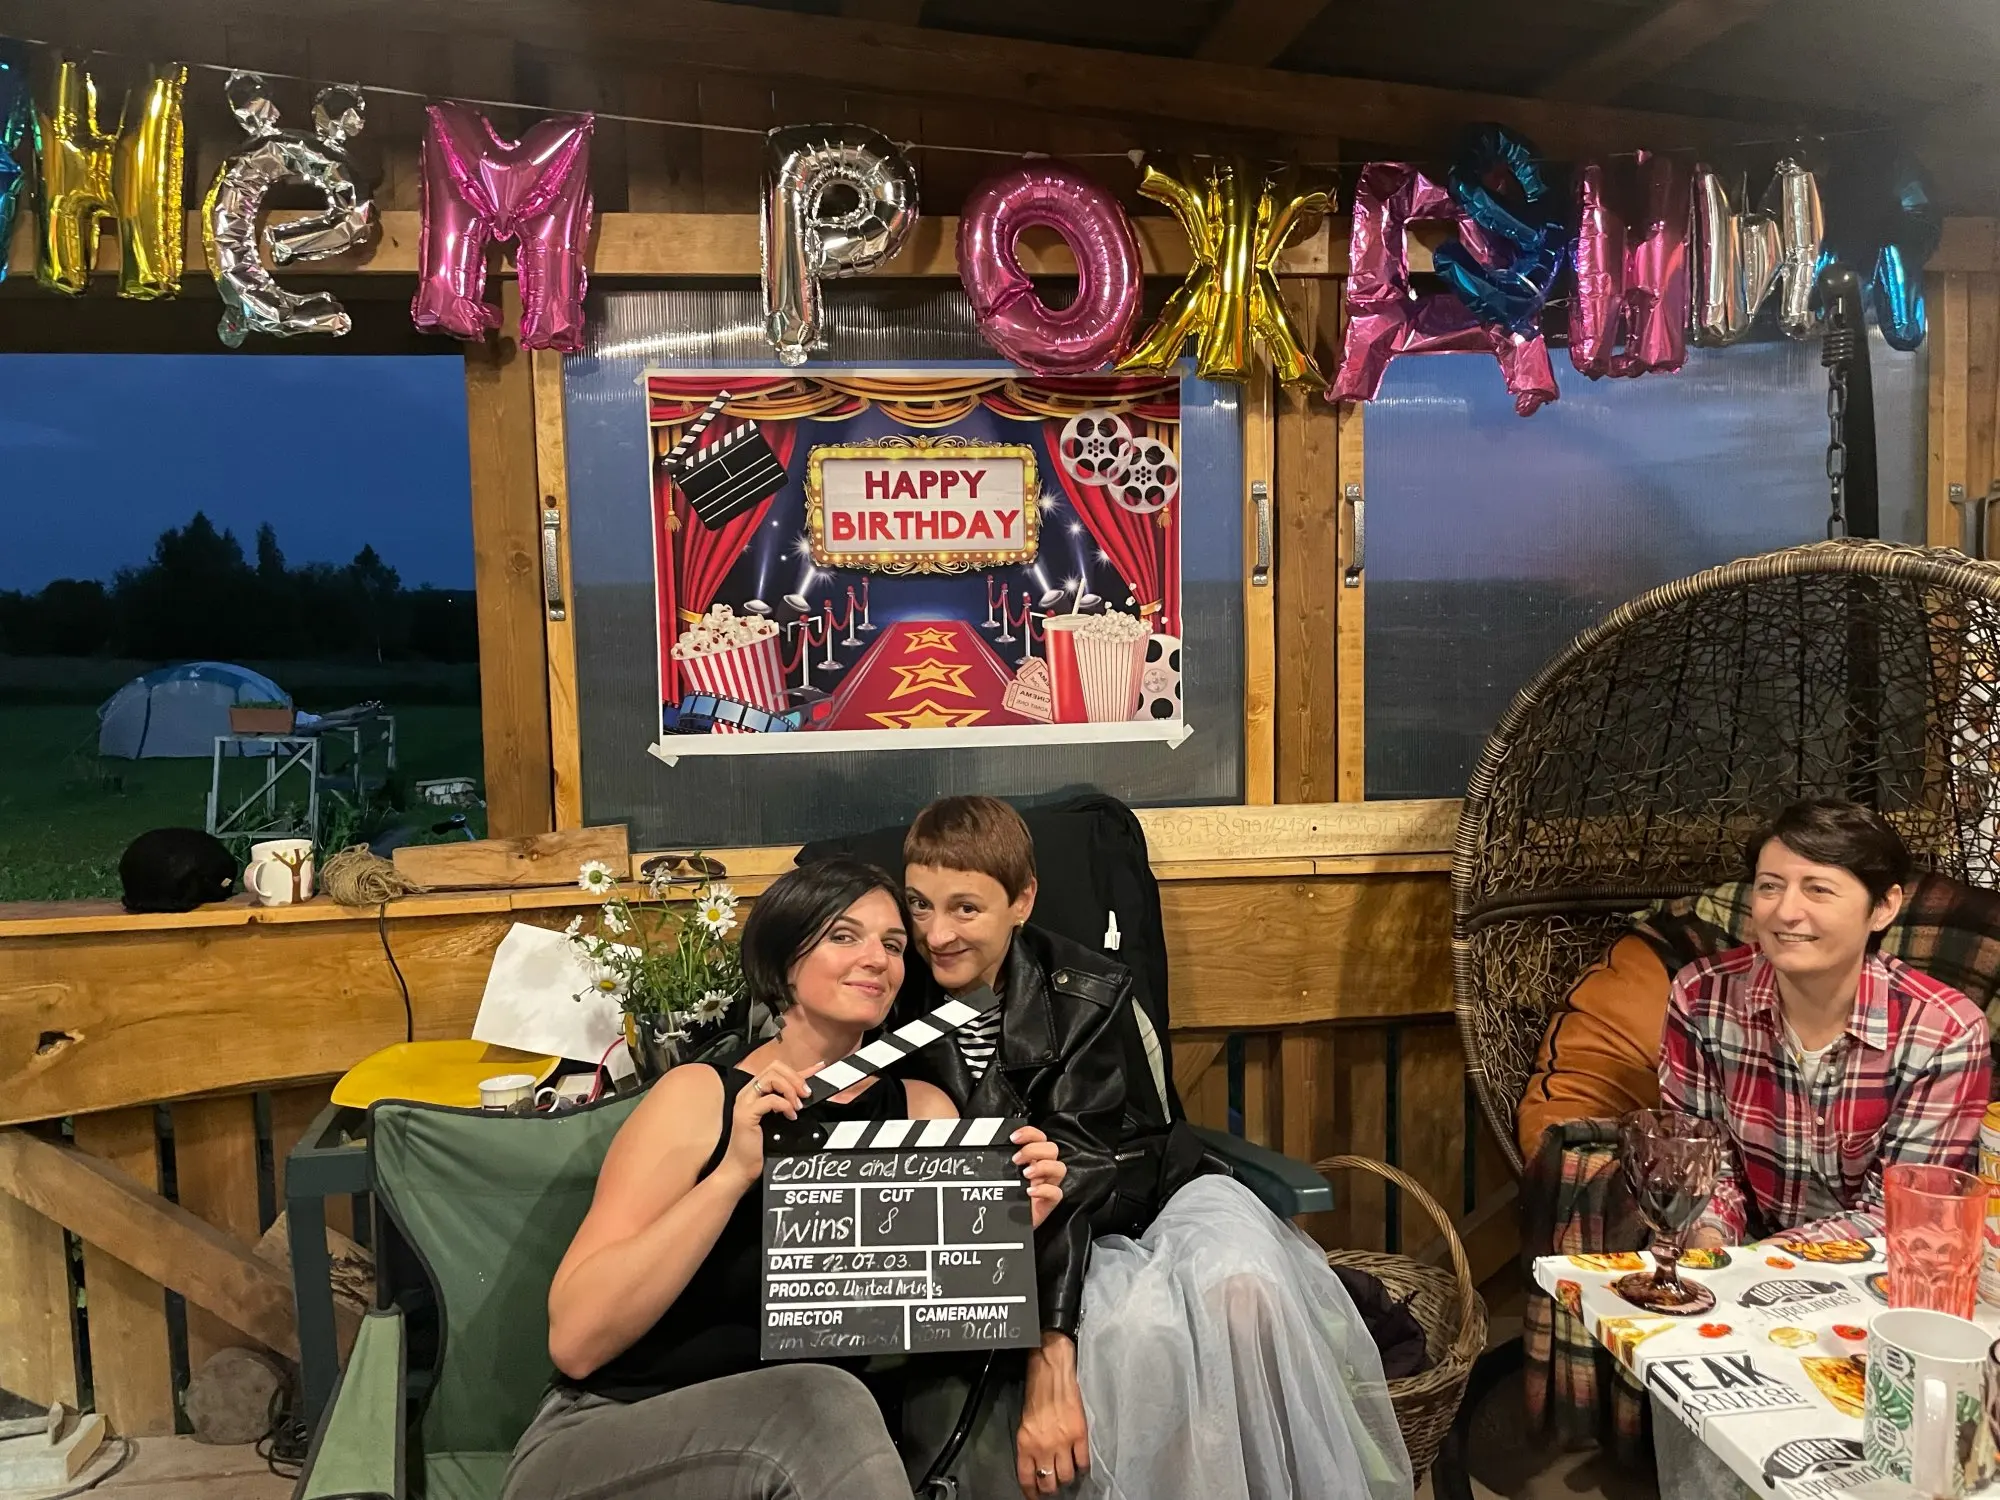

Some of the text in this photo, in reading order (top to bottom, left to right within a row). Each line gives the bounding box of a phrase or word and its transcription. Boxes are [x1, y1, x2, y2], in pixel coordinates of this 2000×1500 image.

[865, 470, 987, 500] HAPPY
[831, 510, 1020, 541] BIRTHDAY
[772, 1153, 851, 1181] Coffee
[859, 1154, 898, 1178] and
[784, 1190, 843, 1205] SCENE
[879, 1188, 914, 1203] CUT
[961, 1188, 1004, 1201] TAKE
[768, 1206, 853, 1247] Twins
[878, 1207, 899, 1234] 8
[971, 1206, 987, 1235] 8
[769, 1255, 814, 1270] DATE
[938, 1251, 982, 1266] ROLL
[769, 1282, 839, 1298] PROD.CO.
[842, 1279, 893, 1297] United
[767, 1310, 843, 1327] DIRECTOR
[915, 1305, 1009, 1322] CAMERAMAN
[1646, 1355, 1785, 1402] TEAK
[1682, 1387, 1809, 1429] ARNAISE
